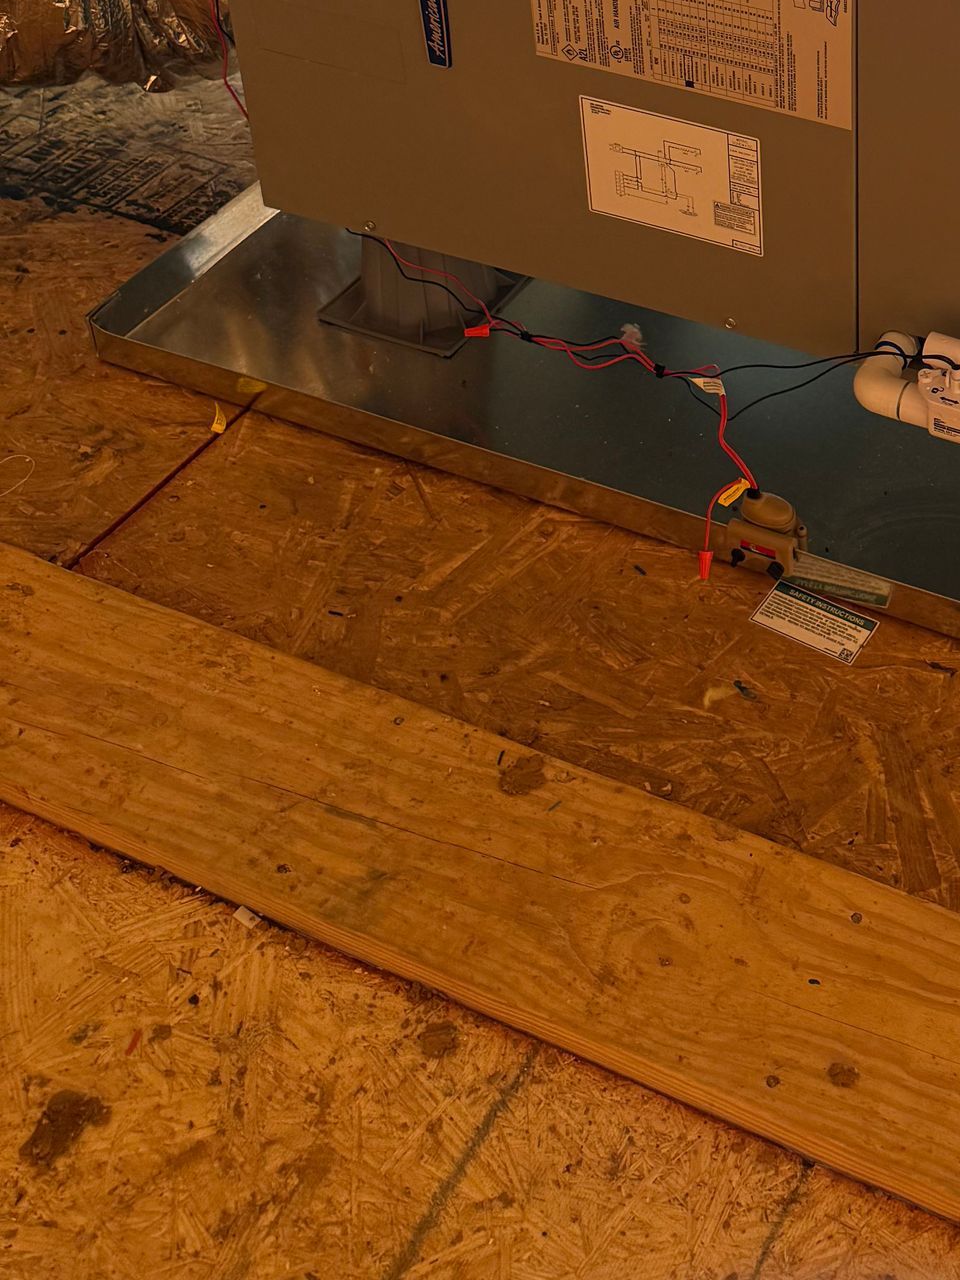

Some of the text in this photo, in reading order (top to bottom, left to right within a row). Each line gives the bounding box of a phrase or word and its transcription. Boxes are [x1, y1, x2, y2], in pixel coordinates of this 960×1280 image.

[577, 46, 588, 61] A2L
[788, 589, 865, 625] SAFETY INSTRUCTIONS
